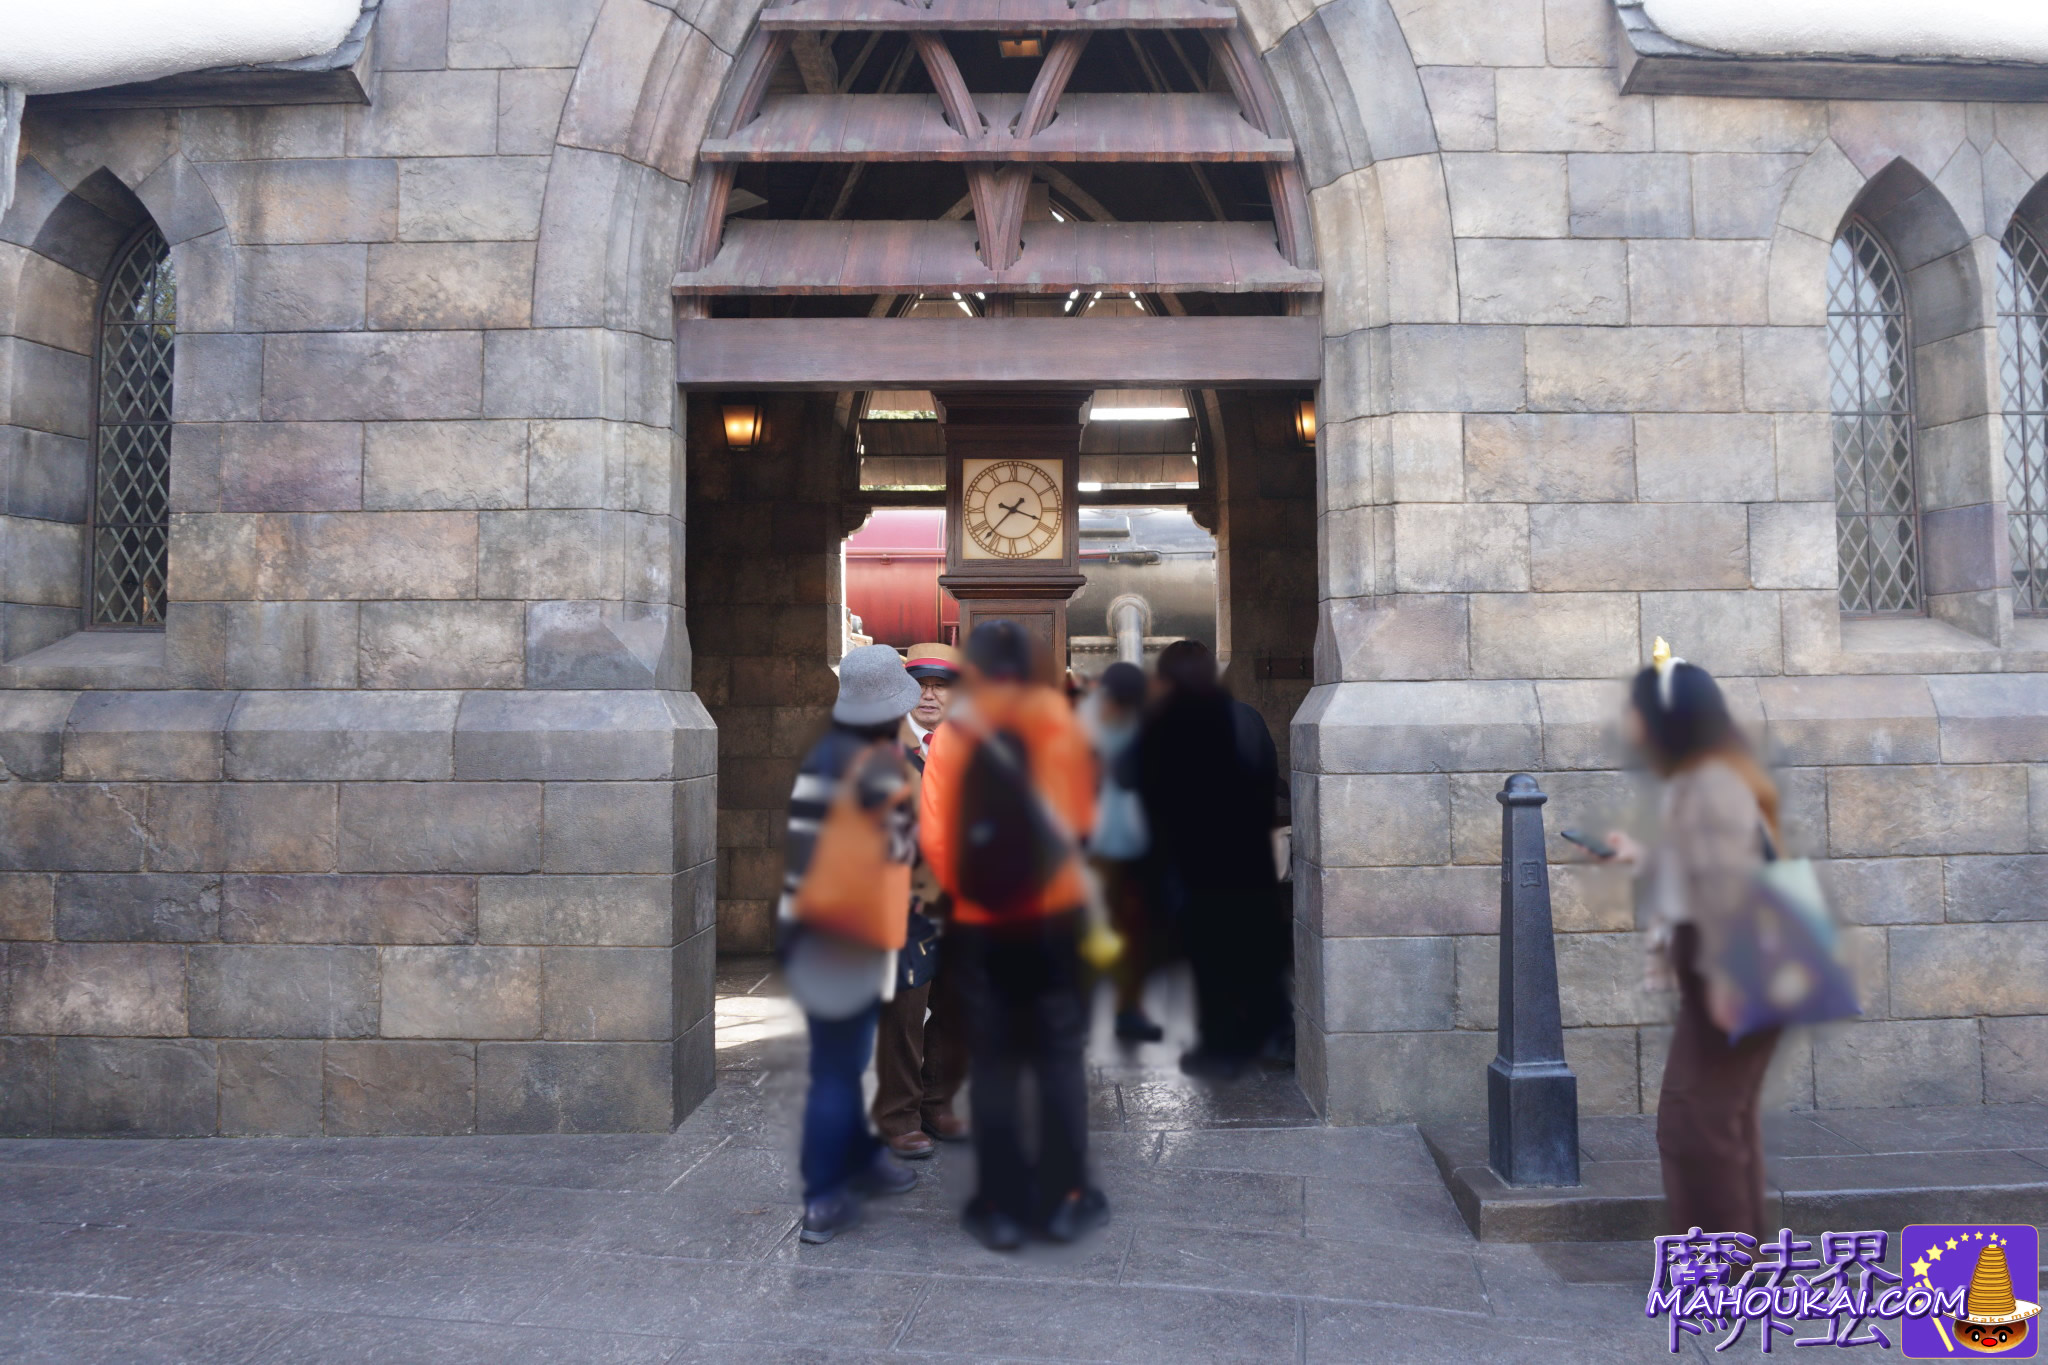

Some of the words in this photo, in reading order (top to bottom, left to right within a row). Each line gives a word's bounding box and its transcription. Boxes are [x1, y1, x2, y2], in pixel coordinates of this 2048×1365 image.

[1008, 464, 1018, 482] XII
[972, 486, 989, 498] X
[1038, 485, 1056, 497] II
